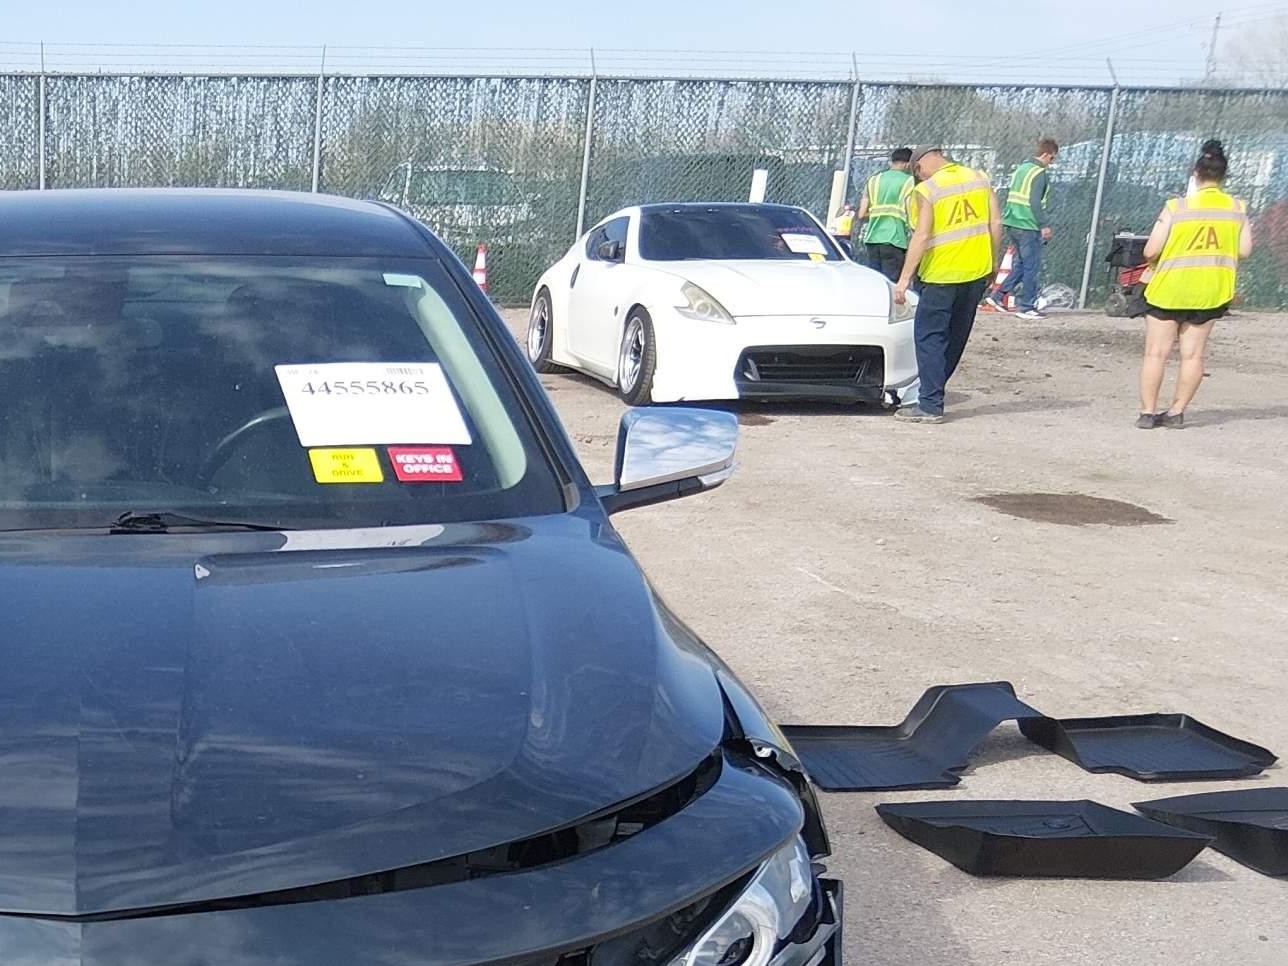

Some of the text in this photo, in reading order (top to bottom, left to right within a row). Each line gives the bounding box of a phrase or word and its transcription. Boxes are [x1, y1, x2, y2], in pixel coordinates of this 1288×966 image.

[301, 380, 430, 396] 44555865
[395, 454, 454, 464] KEYS IN
[402, 464, 453, 474] OFFICE
